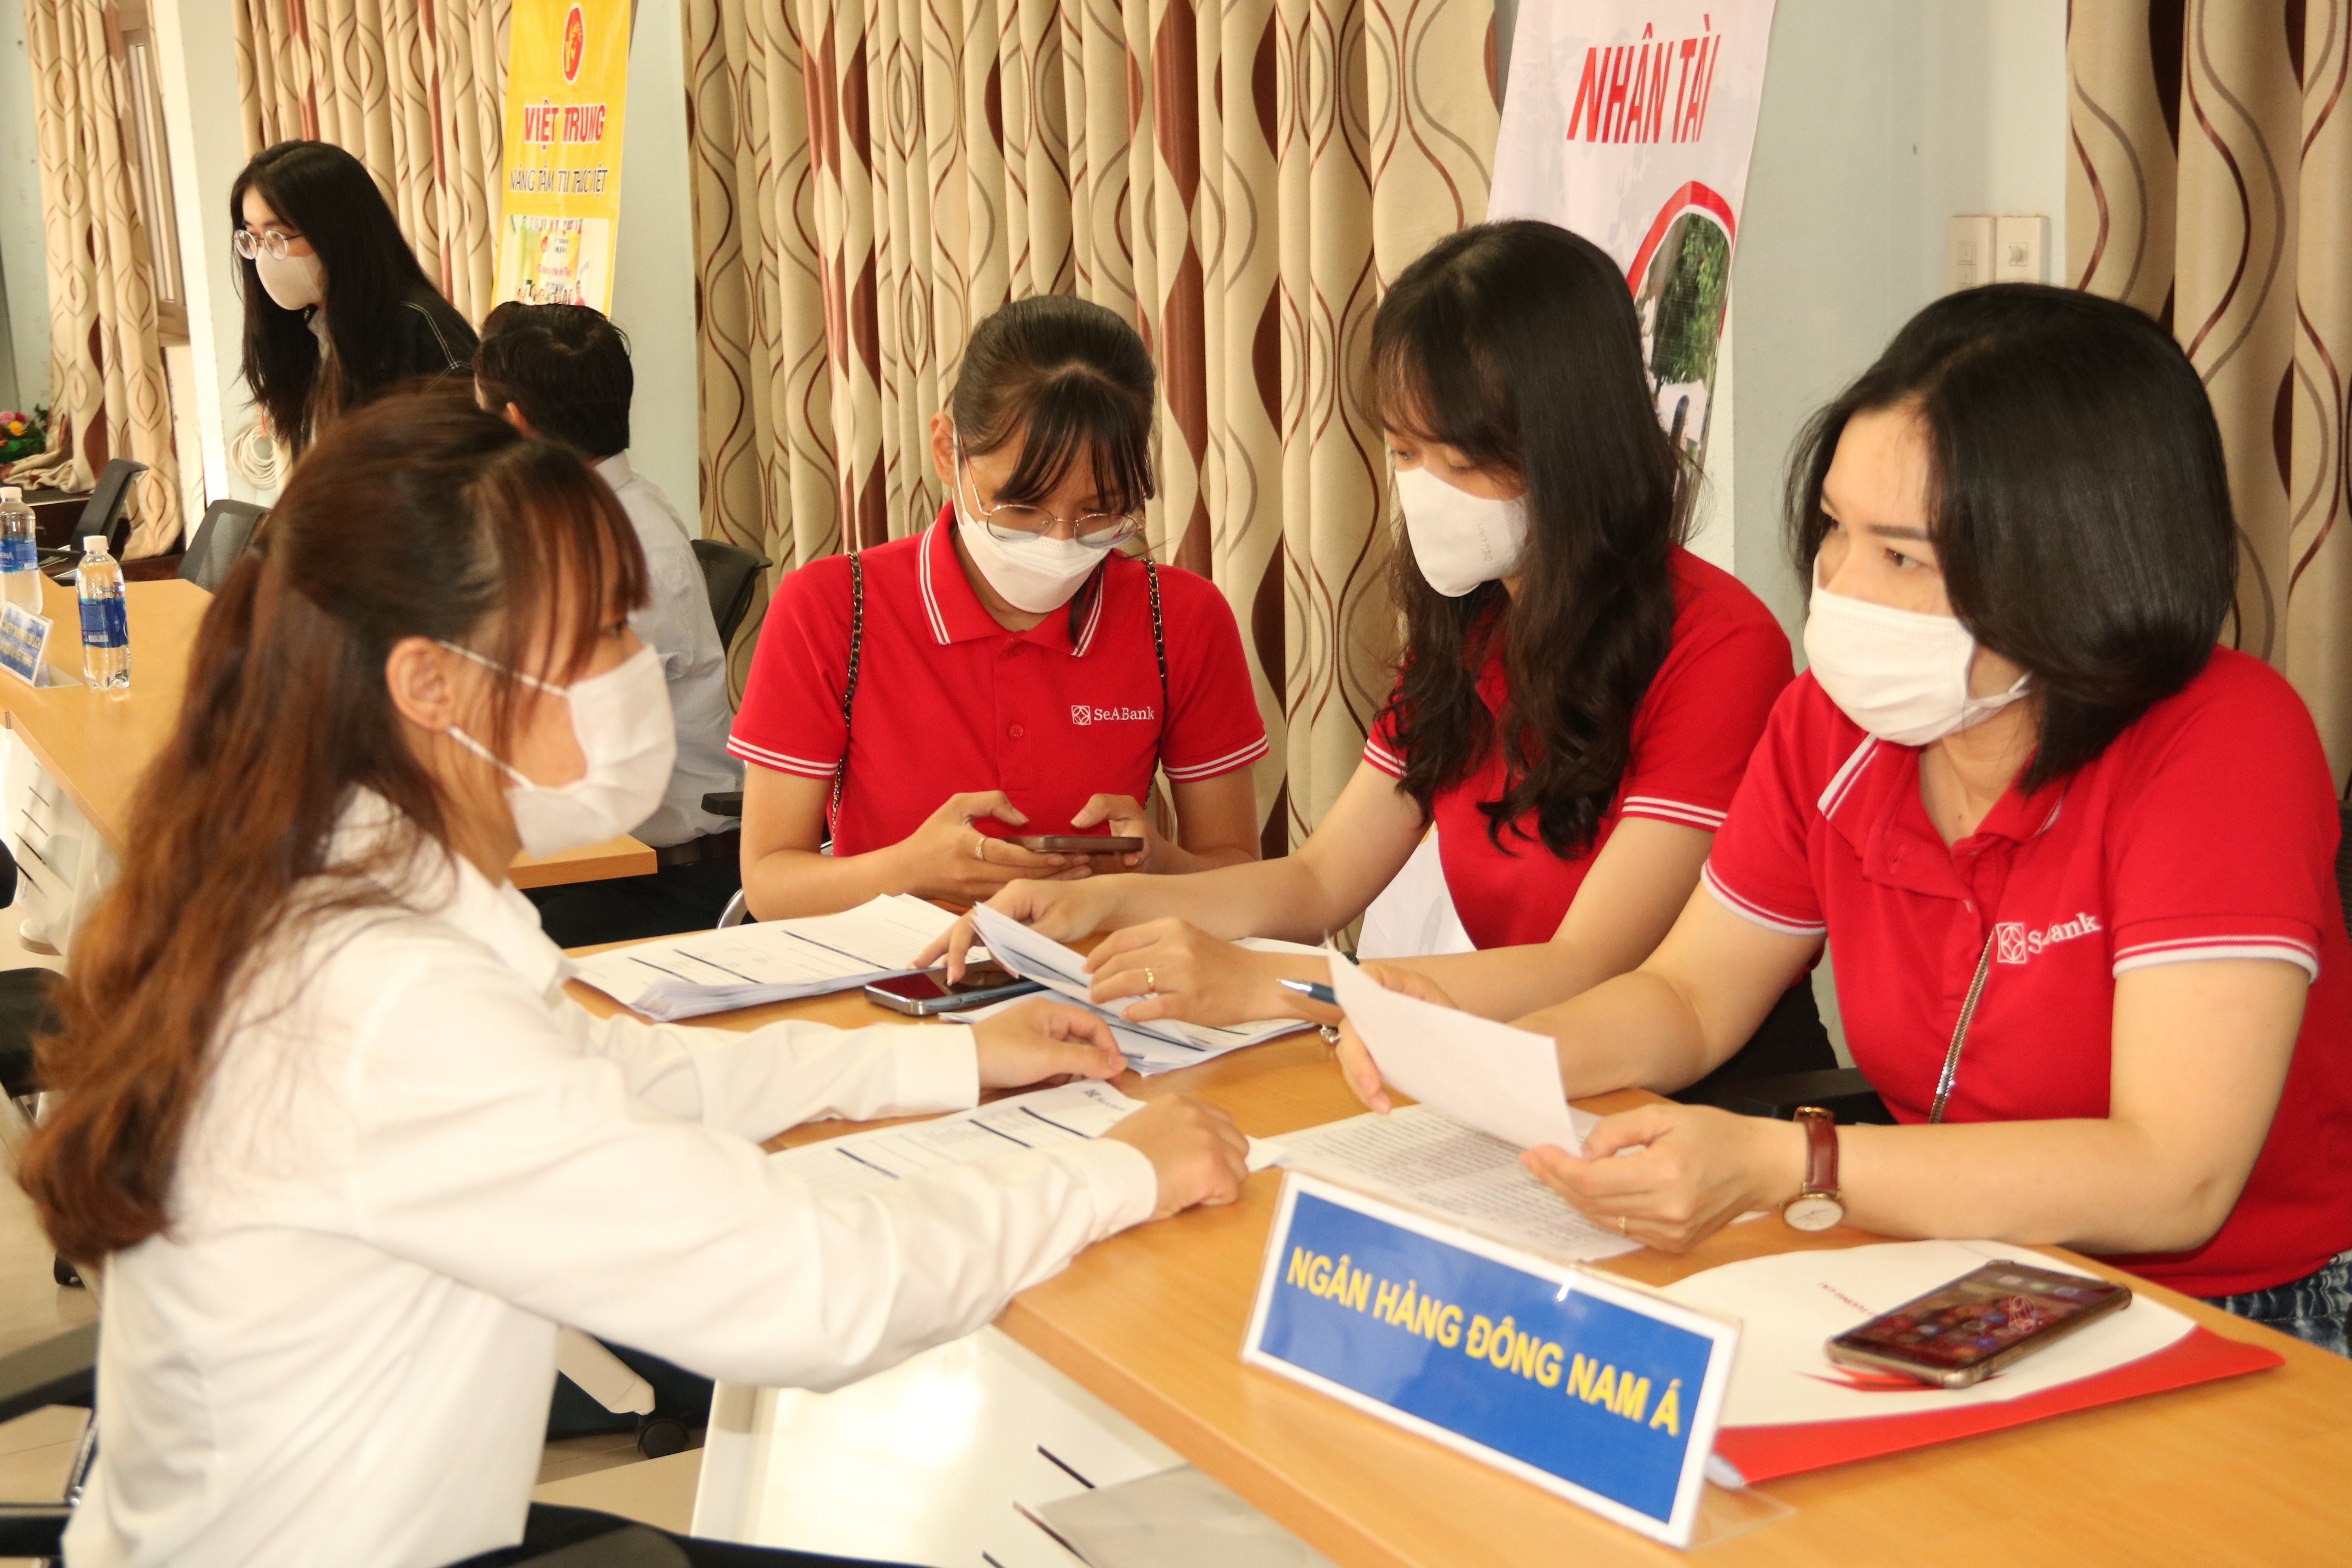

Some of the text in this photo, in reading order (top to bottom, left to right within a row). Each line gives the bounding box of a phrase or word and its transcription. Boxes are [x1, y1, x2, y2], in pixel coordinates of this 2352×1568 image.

[1566, 13, 1721, 144] NHÂN TÀI
[524, 99, 606, 151] VIỆT TRUNG
[1094, 706, 1154, 721] SeABank
[1287, 1246, 1683, 1437] NGÂN HÀNG ĐÔNG NAM Á
